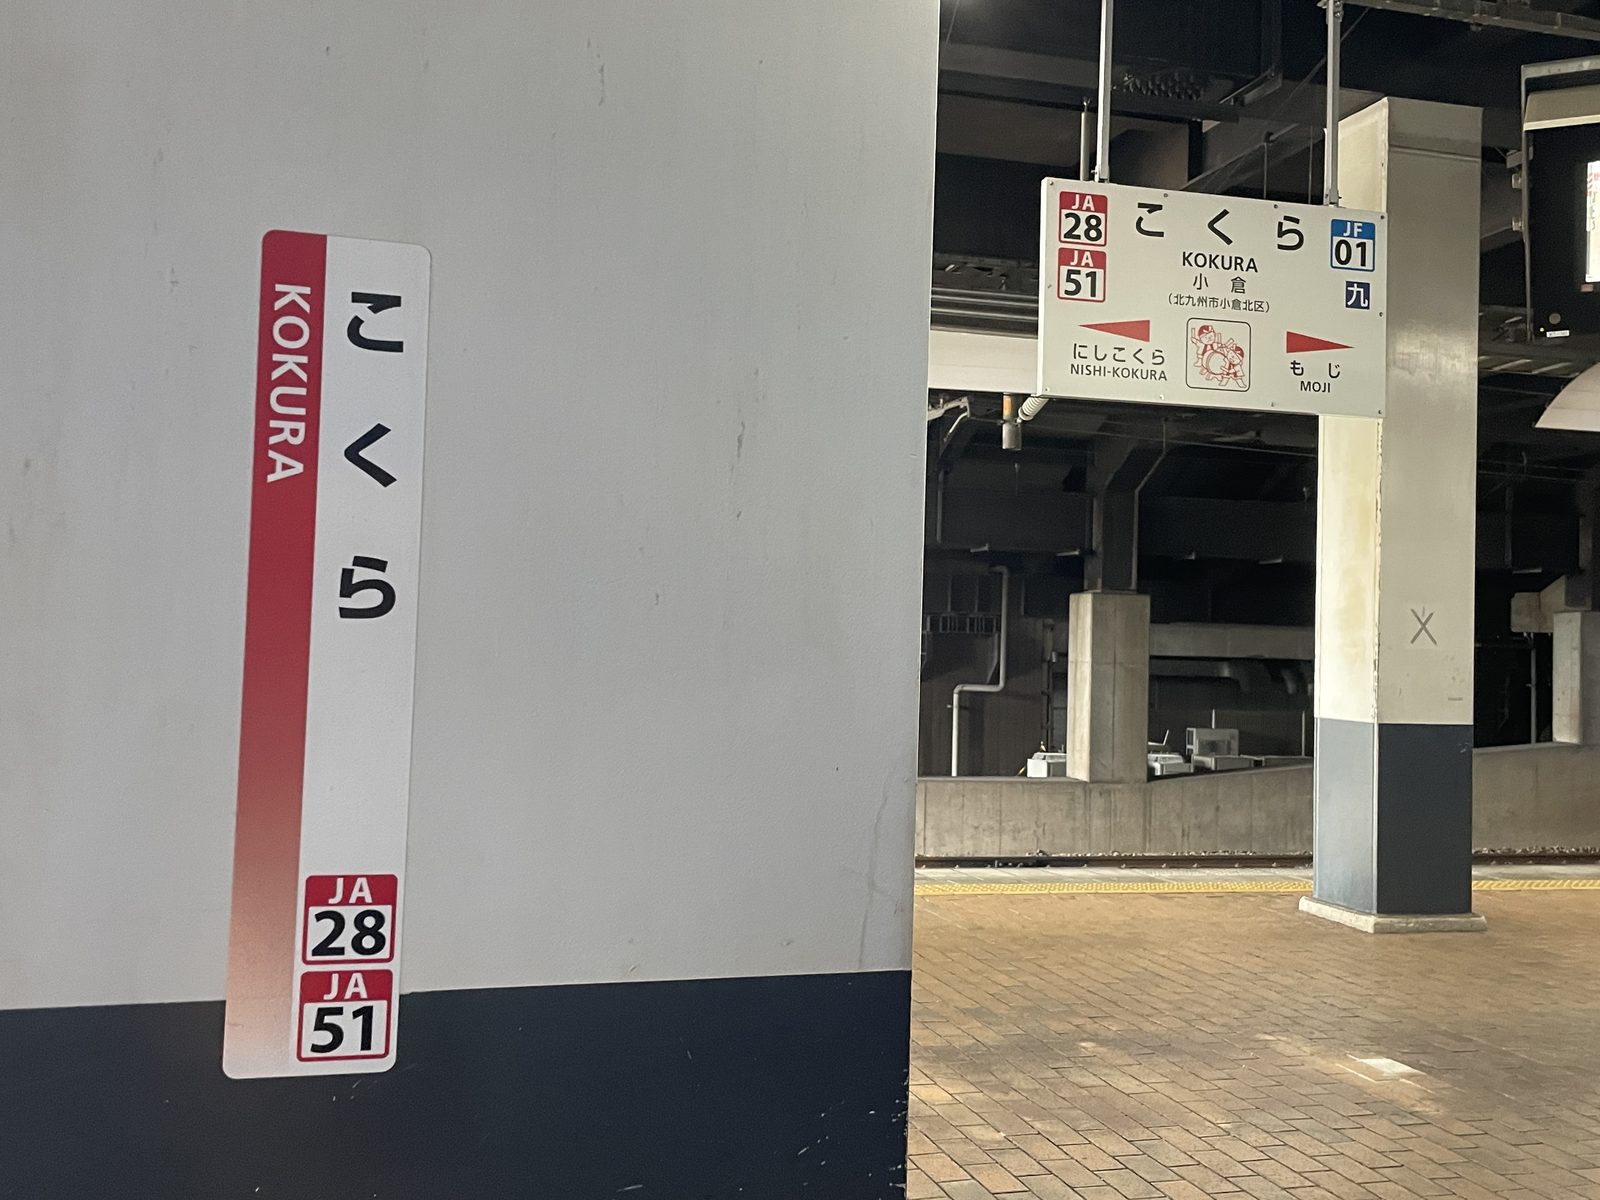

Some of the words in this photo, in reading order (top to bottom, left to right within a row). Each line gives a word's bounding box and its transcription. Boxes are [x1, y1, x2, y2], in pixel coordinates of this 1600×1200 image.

[1072, 195, 1095, 210] JA
[1064, 213, 1102, 242] 28
[1135, 202, 1305, 250] こくら
[1344, 222, 1363, 237] JF
[1070, 250, 1094, 267] JA
[1182, 252, 1258, 273] KOKURA
[1334, 241, 1368, 267] 01
[1064, 270, 1096, 297] 51
[1192, 273, 1247, 293] 小倉
[1347, 284, 1368, 307] 九
[1073, 343, 1165, 365] にしこくら
[1070, 364, 1167, 381] NISHI-KOKURA
[1290, 360, 1341, 379] もじ
[266, 283, 311, 483] KOKURA
[1300, 380, 1331, 393] MOJI
[339, 291, 404, 619] こくら
[329, 878, 372, 904] JA
[312, 910, 386, 956] 28
[323, 973, 367, 1000] JA
[310, 1006, 374, 1053] 51
